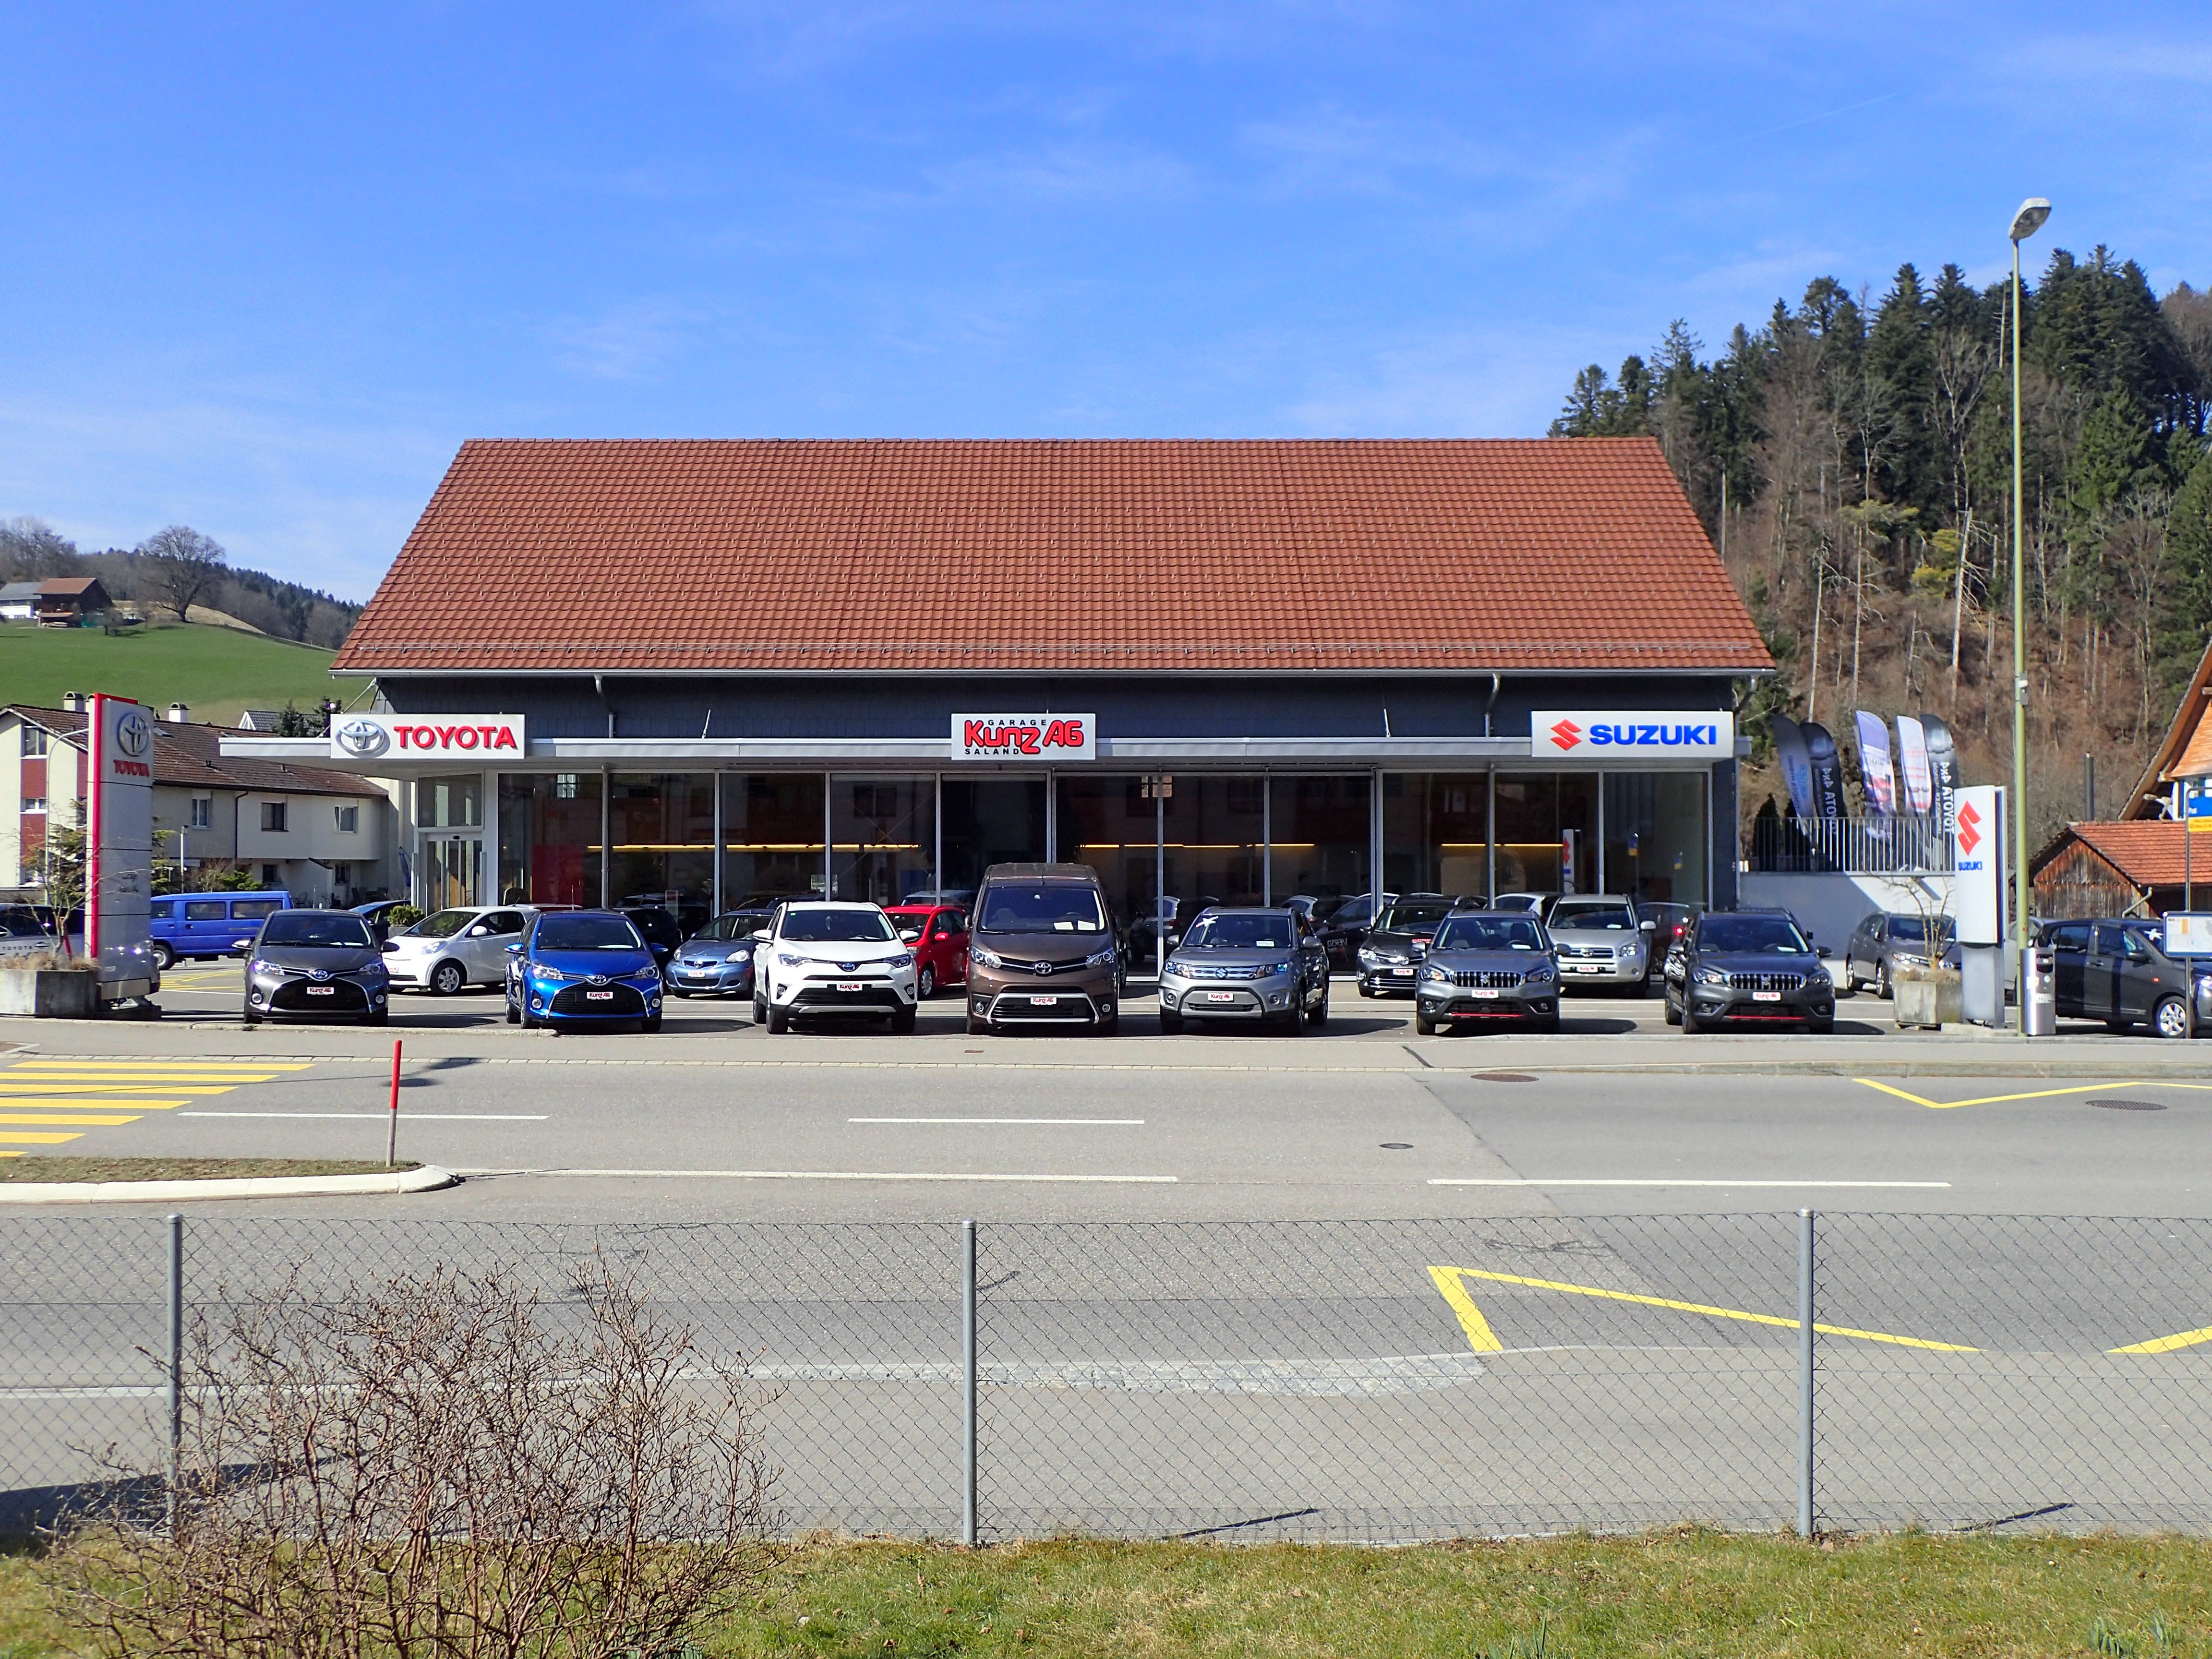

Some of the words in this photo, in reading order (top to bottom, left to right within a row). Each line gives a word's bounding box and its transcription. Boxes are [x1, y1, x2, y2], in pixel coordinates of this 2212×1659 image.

[393, 725, 517, 749] TOYOTA
[964, 720, 1041, 755] Kunz
[1042, 720, 1084, 747] AG
[1589, 724, 1717, 745] SUZUKI
[113, 759, 150, 777] TOYOTA
[1958, 861, 1983, 871] SUZUKI
